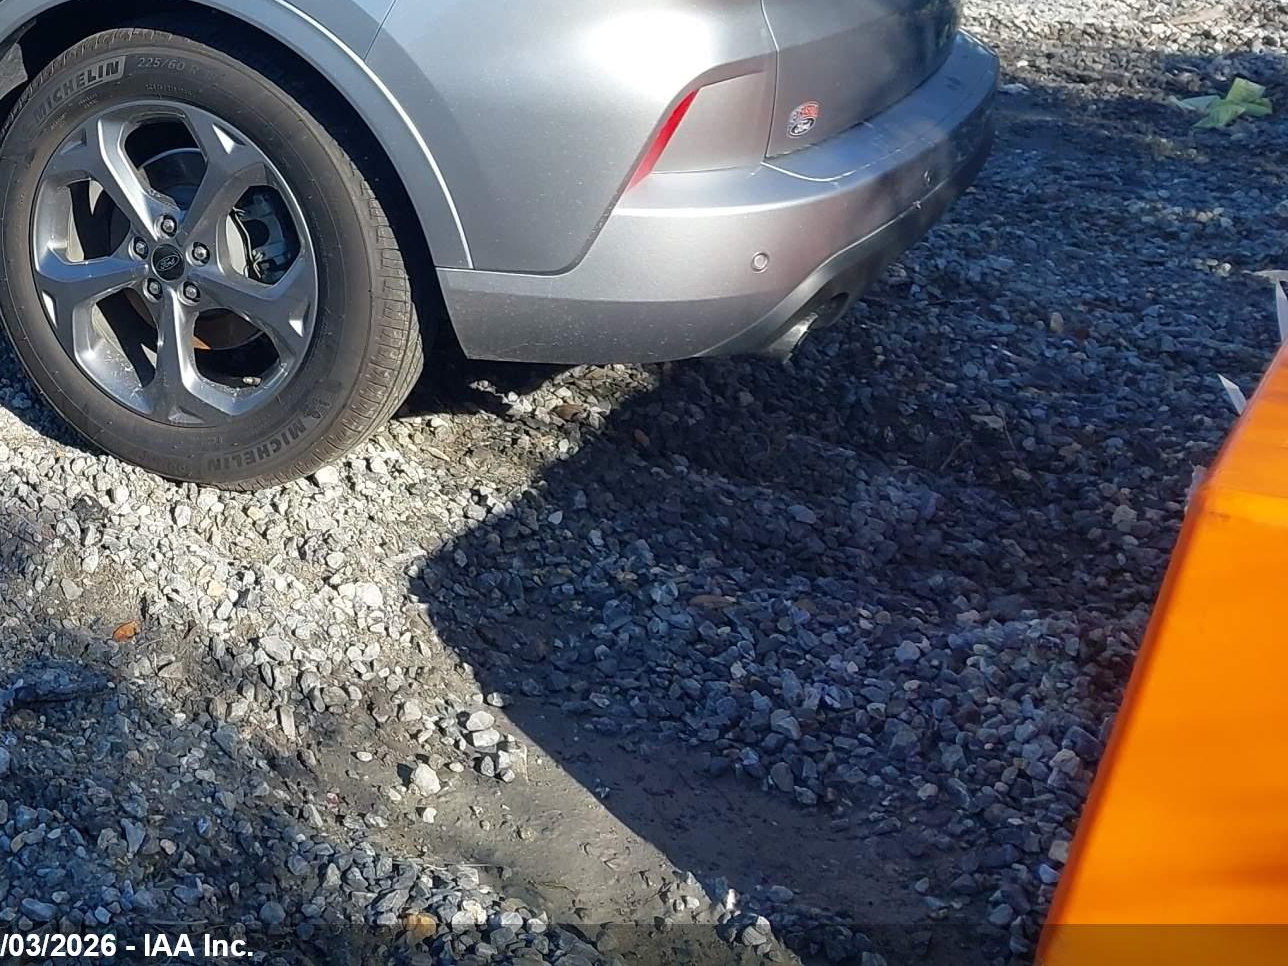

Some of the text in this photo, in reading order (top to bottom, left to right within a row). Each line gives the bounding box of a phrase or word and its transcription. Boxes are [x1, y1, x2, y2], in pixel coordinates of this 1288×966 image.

[33, 60, 120, 123] MICHELIN
[136, 56, 186, 72] 225/60
[206, 417, 308, 472] MICHELIN
